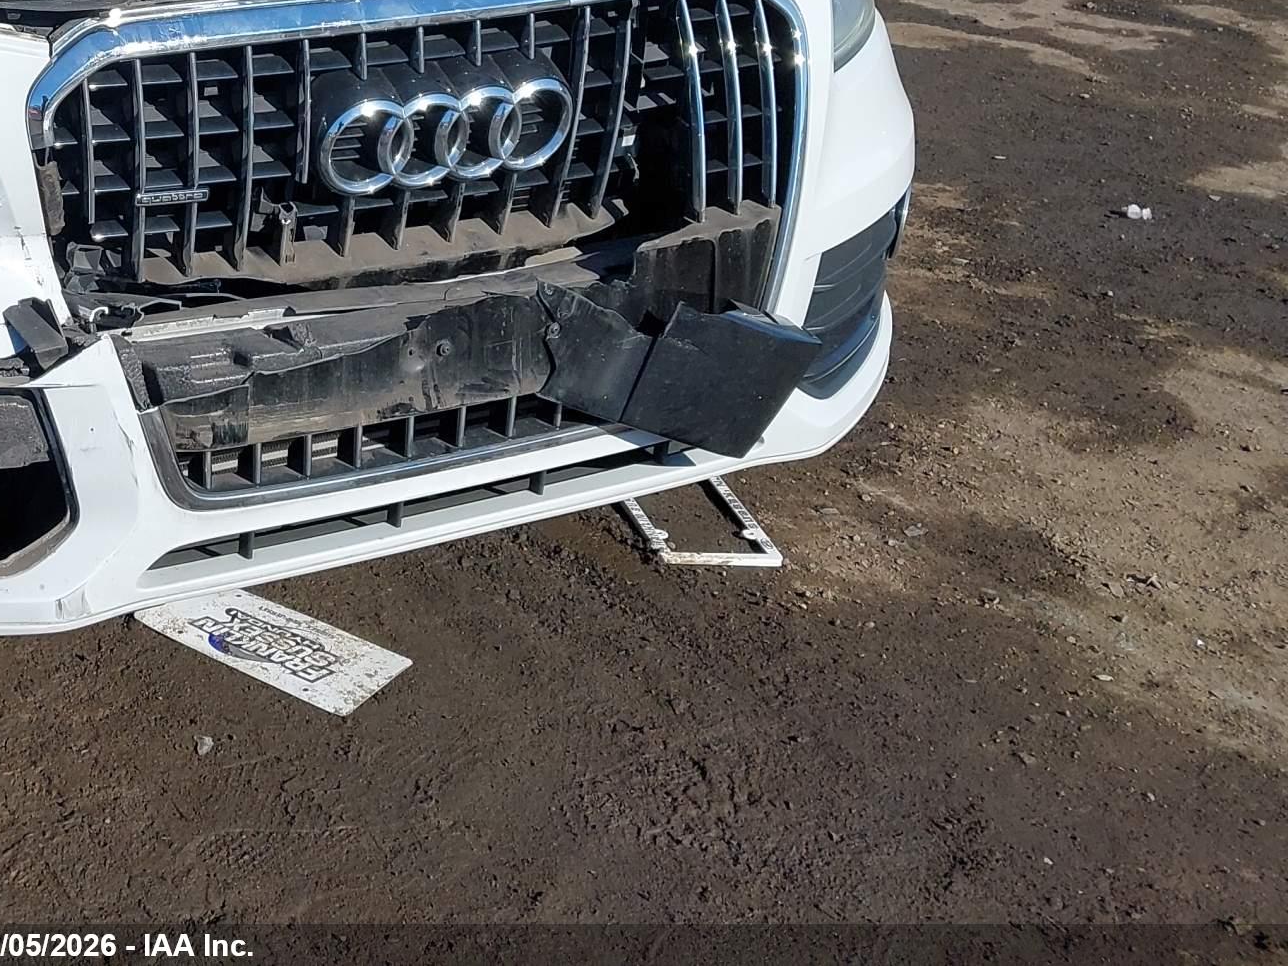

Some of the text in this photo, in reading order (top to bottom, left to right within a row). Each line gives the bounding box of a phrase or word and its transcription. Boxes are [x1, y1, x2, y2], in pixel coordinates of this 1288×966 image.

[142, 193, 204, 205] quattro
[194, 616, 332, 681] FRANKLIN
[224, 617, 337, 668] SUSSEX
[229, 609, 323, 650] HYUNDAI
